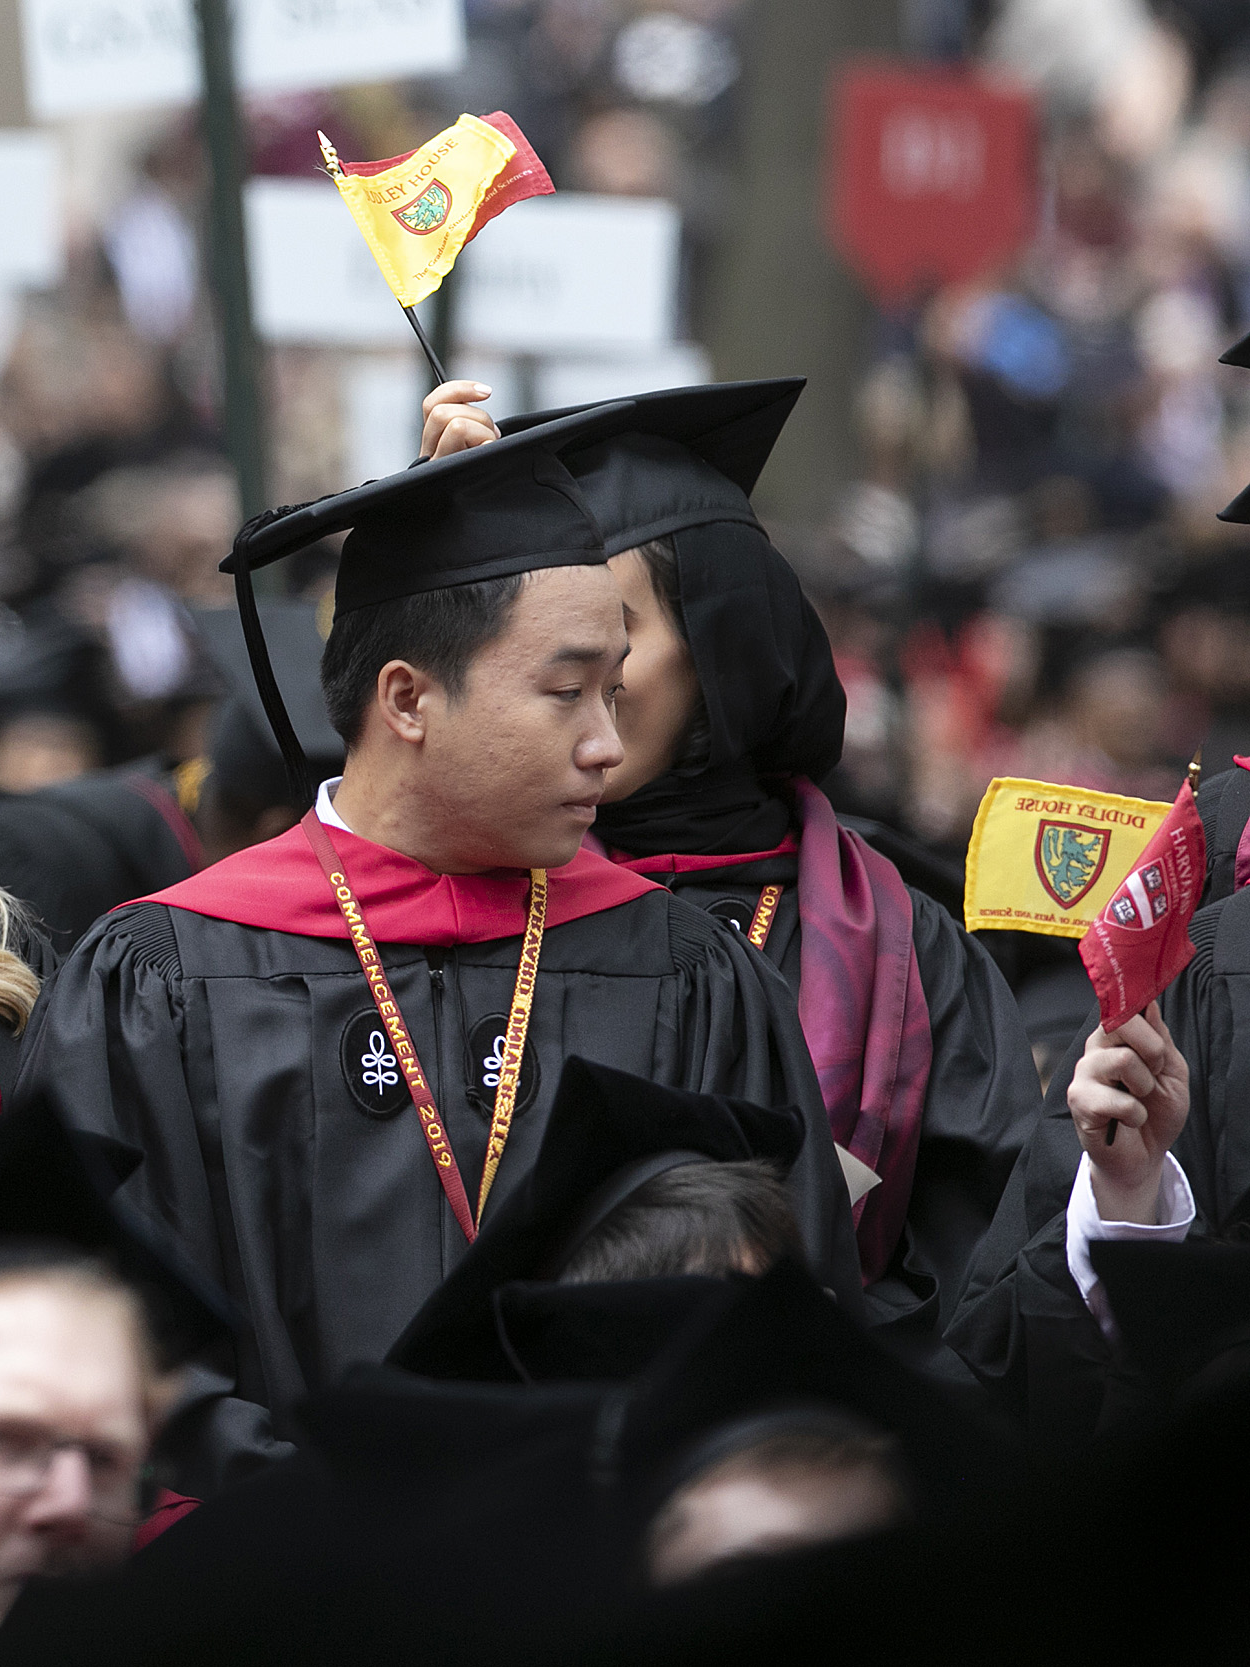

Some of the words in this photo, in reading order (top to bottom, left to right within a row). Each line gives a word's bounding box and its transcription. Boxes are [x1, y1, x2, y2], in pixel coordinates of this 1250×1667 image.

[364, 184, 407, 204] UDLEY
[408, 138, 459, 187] HOUSE
[485, 187, 498, 202] and
[497, 168, 533, 189] Sciences
[413, 267, 428, 281] The
[427, 231, 449, 267] Graduate
[330, 872, 425, 1090] COMMENCEMENT
[420, 1104, 451, 1167] 2019
